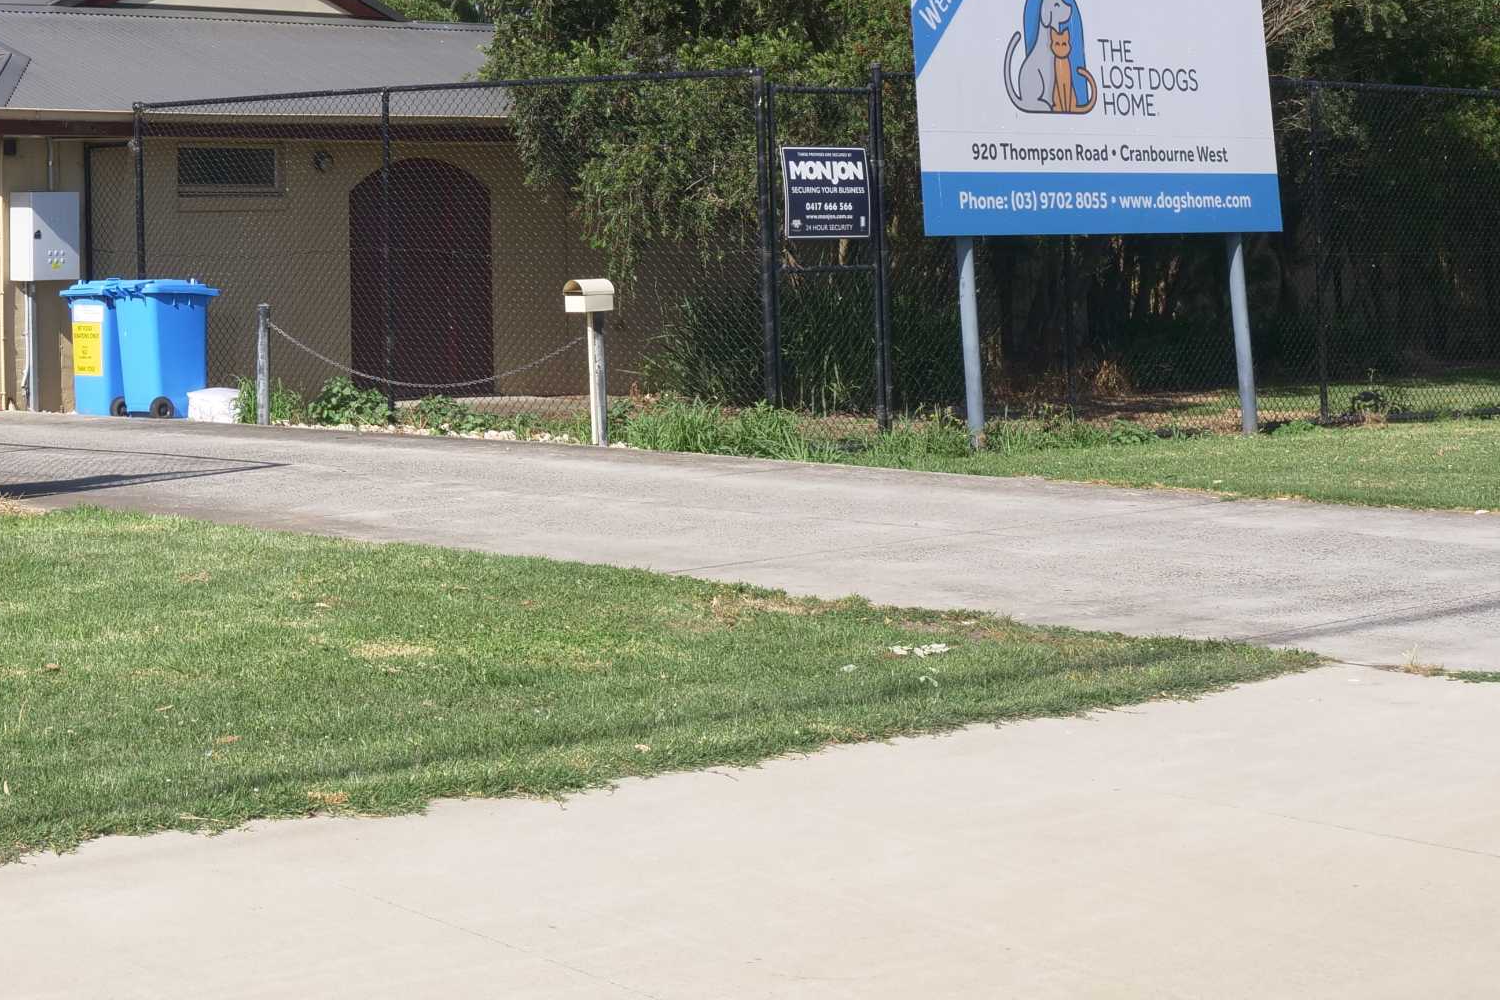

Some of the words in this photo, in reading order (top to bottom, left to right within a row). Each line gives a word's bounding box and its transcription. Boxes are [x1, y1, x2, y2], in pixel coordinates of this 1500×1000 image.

[1097, 38, 1134, 63] THE
[1100, 65, 1145, 90] LOST
[1148, 67, 1199, 92] DOGS
[1102, 92, 1156, 117] HOME
[971, 142, 998, 161] 920
[999, 142, 1073, 166] Thompson
[1075, 143, 1109, 162] Road
[1119, 144, 1195, 163] Cranbourne
[1196, 145, 1229, 163] West
[788, 160, 865, 185] MONJON
[791, 186, 820, 194] SECURING
[821, 186, 838, 194] YOUR
[838, 186, 865, 194] BUSINESS
[959, 191, 1008, 209] Phone:
[1011, 190, 1037, 211] (03)
[1039, 191, 1073, 209] 9702
[1075, 191, 1108, 209] 8055
[1119, 191, 1251, 213] www.dogshome.com
[805, 202, 822, 211] 0417
[824, 202, 837, 211] 666
[839, 202, 853, 211] 566
